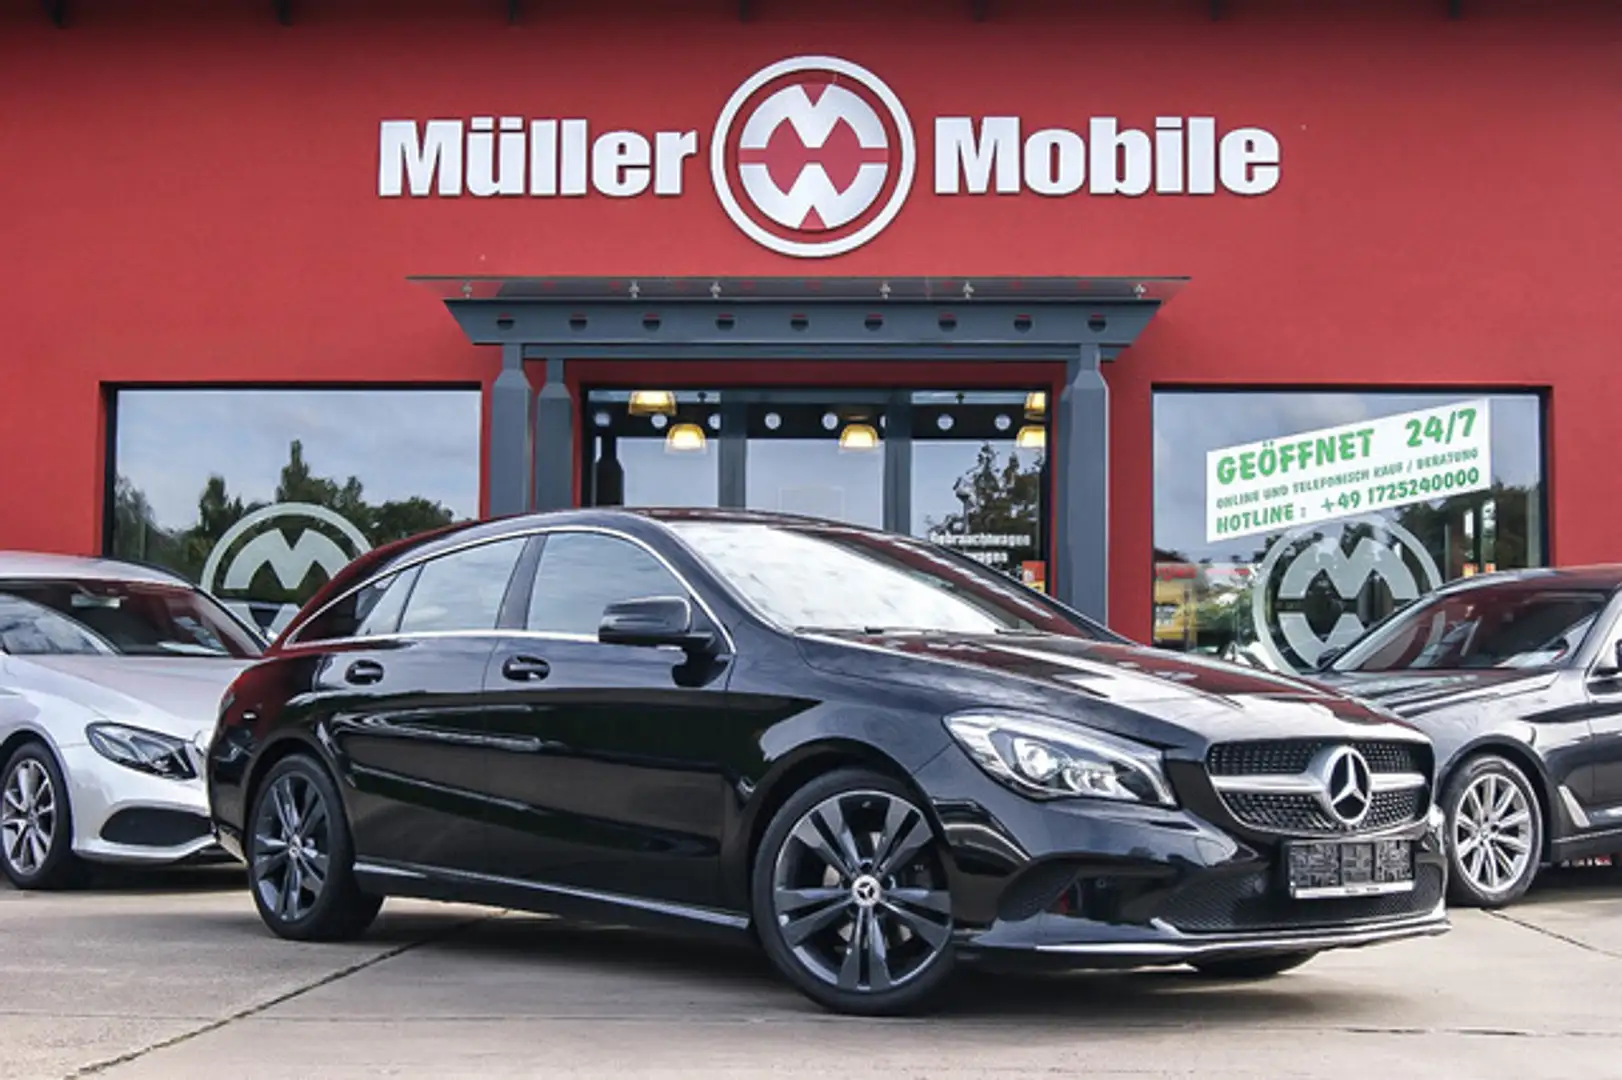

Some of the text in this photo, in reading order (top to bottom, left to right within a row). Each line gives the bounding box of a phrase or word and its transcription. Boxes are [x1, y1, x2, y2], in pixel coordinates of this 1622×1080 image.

[379, 116, 697, 197] Müller
[934, 116, 1280, 196] Mobile
[1216, 408, 1476, 485] GEÖFFNET 24/7
[1216, 490, 1259, 509] ONLINE
[1262, 484, 1289, 500] UND
[1292, 469, 1370, 493] TELEFONISCH
[1373, 461, 1403, 478] KAUF
[1416, 447, 1478, 470] BERATUNG
[1216, 503, 1293, 534] HOTLINE
[1320, 489, 1361, 512] +49
[1368, 466, 1479, 505] 1725240000
